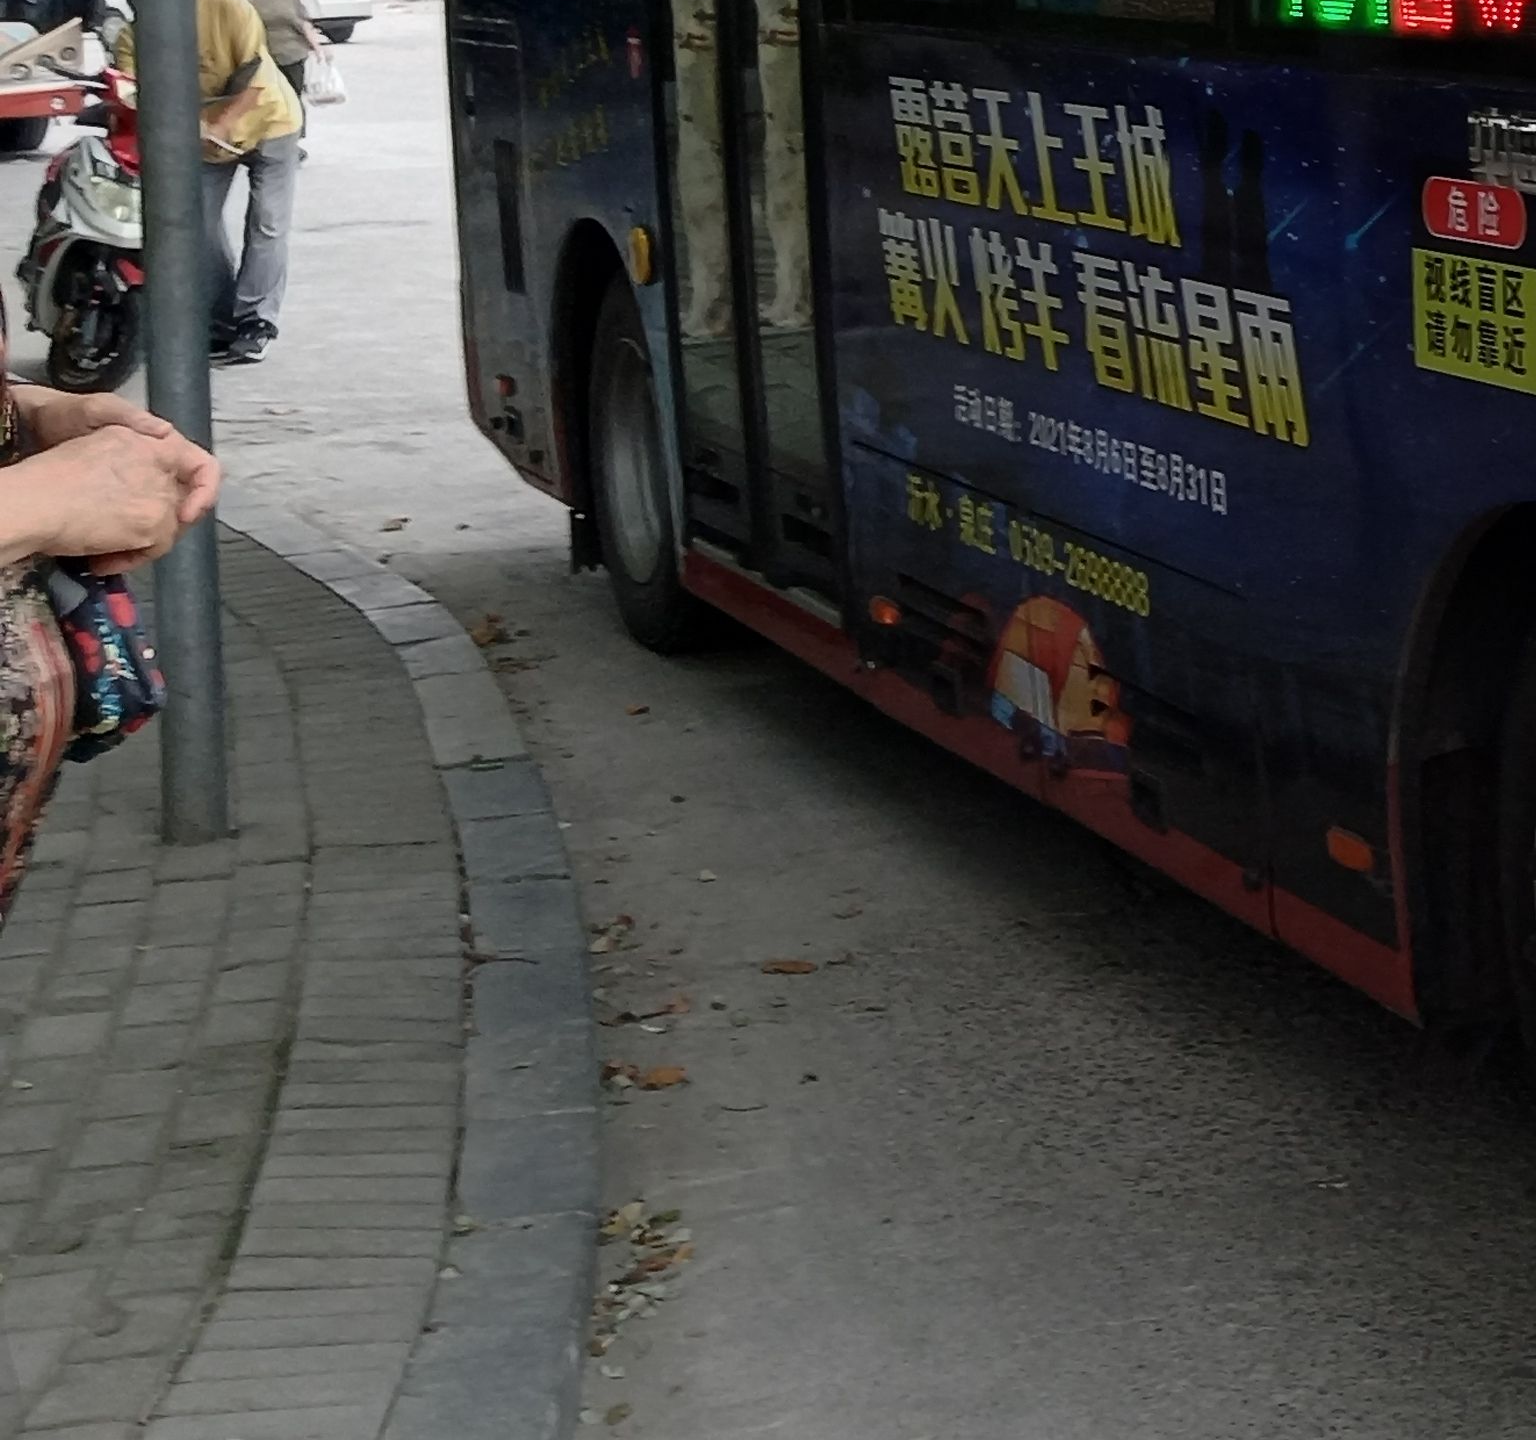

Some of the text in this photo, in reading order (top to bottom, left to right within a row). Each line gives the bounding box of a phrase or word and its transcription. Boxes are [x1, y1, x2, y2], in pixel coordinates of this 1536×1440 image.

[888, 75, 1182, 248] 露营天上王城
[1446, 185, 1501, 237] 危险
[1424, 256, 1526, 320] 视线盲区
[877, 207, 1310, 448] 篝火 烤羊 看流星雨
[1424, 310, 1527, 376] 请勿靠近
